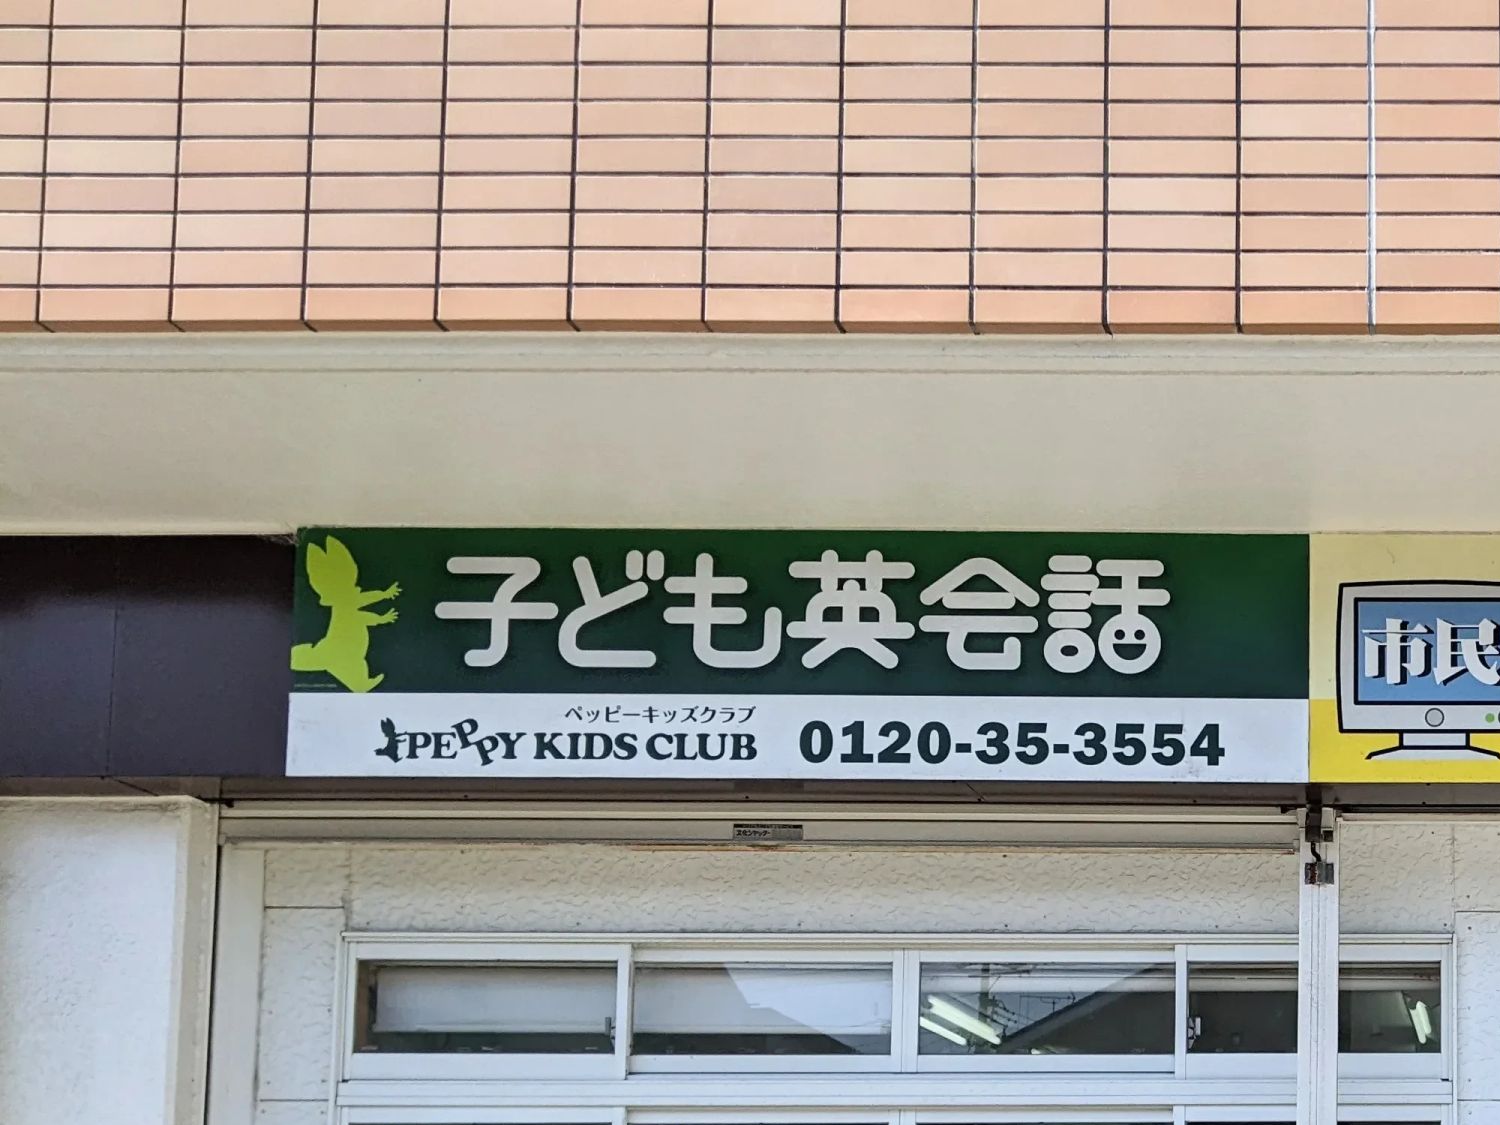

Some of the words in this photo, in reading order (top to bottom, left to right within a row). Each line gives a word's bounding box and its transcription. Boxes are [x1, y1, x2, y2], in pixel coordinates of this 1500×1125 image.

[434, 549, 1171, 675] 子ども英会話
[565, 706, 757, 724] ペッピーキッズクラブ
[406, 718, 526, 766] PEPPY
[534, 732, 637, 761] KIDS
[646, 732, 757, 761] CLUB
[799, 720, 1226, 768] 0120-35-3554
